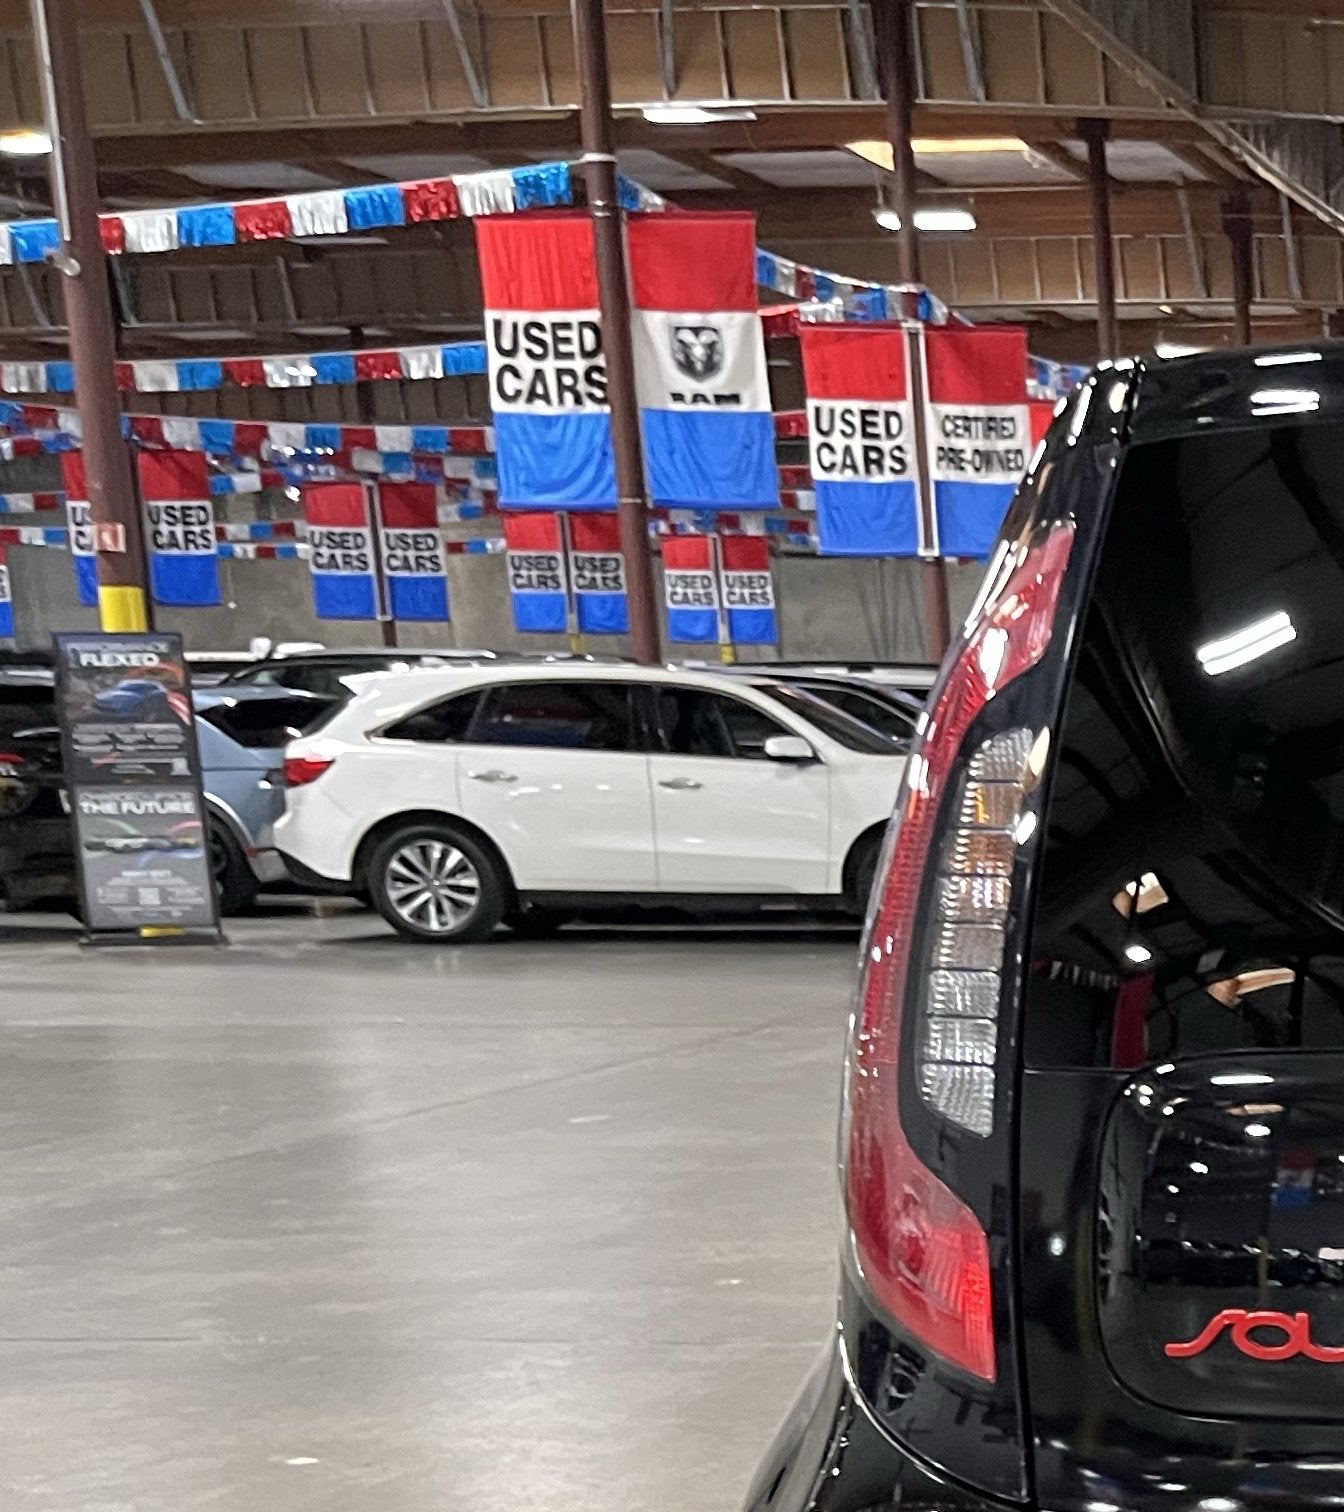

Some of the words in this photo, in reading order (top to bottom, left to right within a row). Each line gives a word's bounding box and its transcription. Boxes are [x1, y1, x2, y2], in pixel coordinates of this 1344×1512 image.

[493, 319, 600, 361] USED
[496, 364, 608, 406] CARS
[815, 406, 903, 441] USED
[816, 442, 907, 476] CARS
[148, 505, 210, 527] USED
[152, 529, 213, 551] CARS
[310, 530, 367, 550] USED
[384, 532, 439, 552] USED
[311, 551, 369, 571] CARS
[386, 554, 442, 572] CARS
[511, 554, 560, 572] USED
[574, 556, 620, 573] USED
[666, 574, 712, 590] USED
[725, 574, 768, 590] USED
